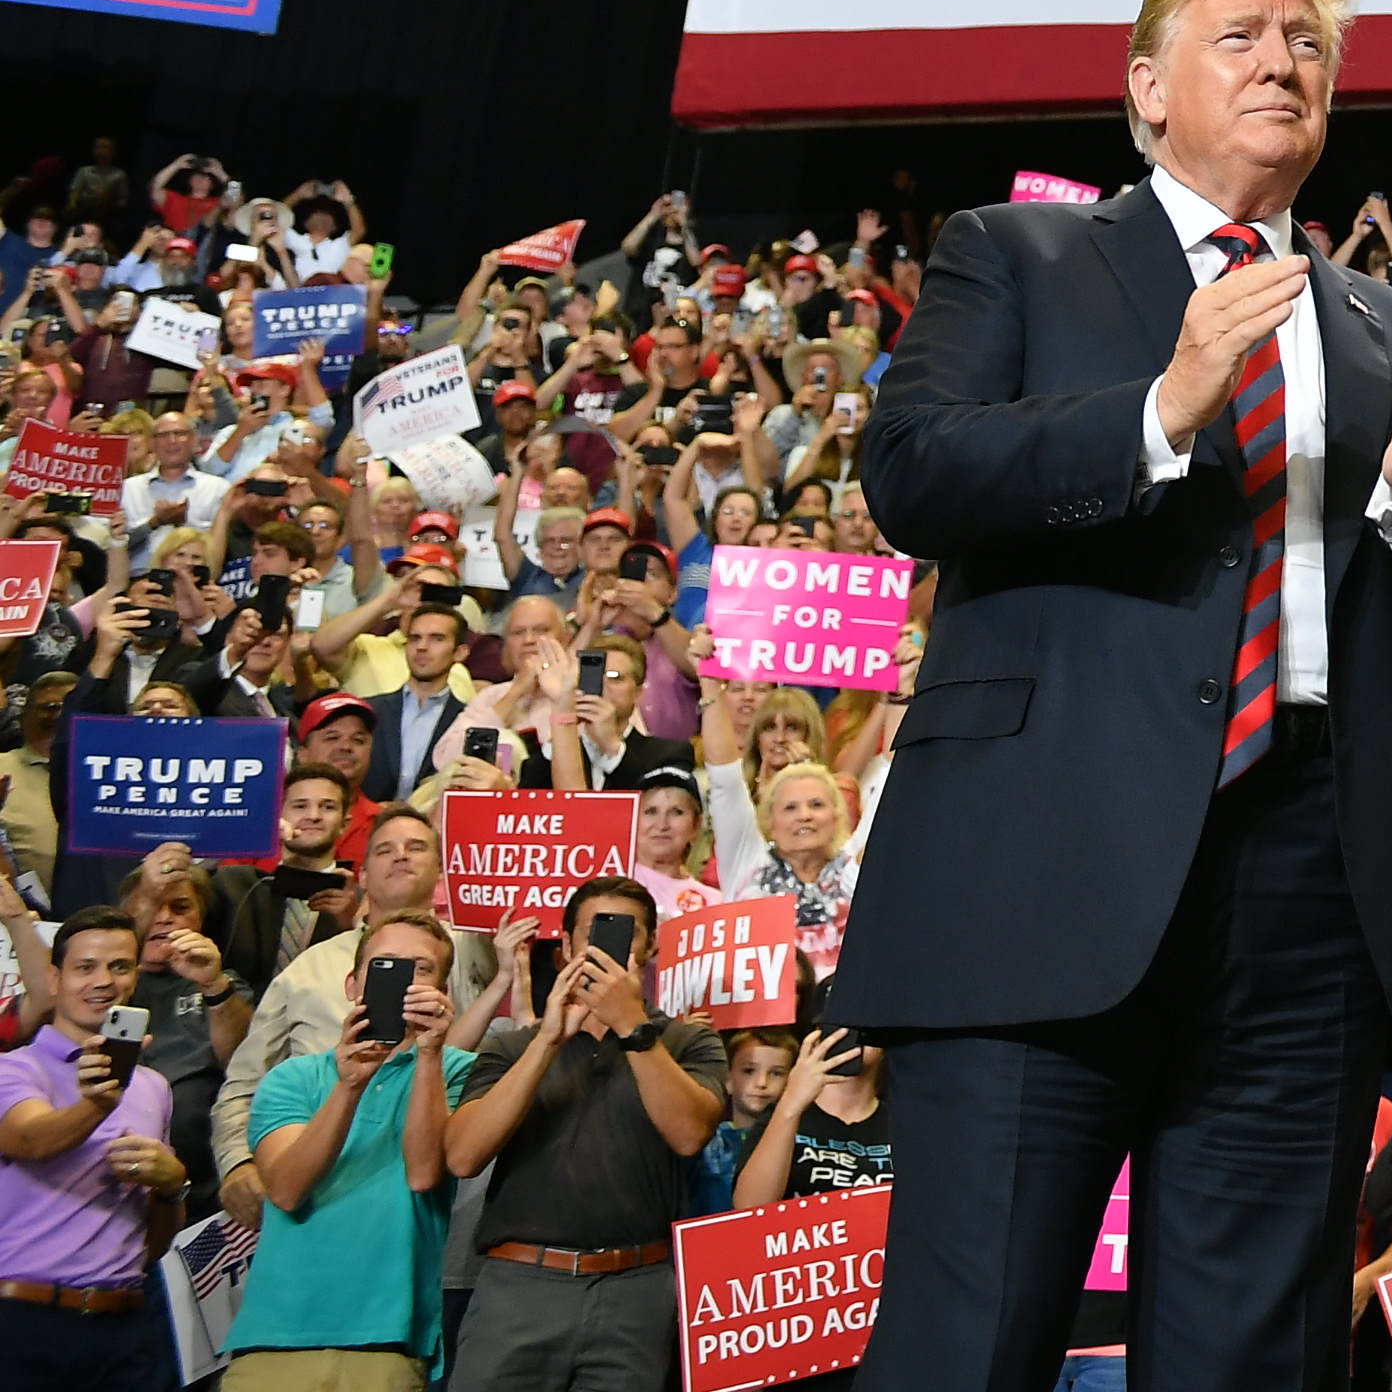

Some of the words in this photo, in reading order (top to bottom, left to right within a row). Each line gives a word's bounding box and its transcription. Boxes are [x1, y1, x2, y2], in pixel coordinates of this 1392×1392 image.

[262, 303, 358, 322] TRUMP
[395, 353, 459, 381] VETERANS
[376, 375, 465, 414] TRUMP
[53, 443, 100, 459] MAKE
[13, 450, 123, 484] AMERICA
[716, 556, 911, 600] WOMEN
[772, 606, 842, 630] FOR
[714, 638, 890, 678] TRUMP
[84, 756, 263, 783] TRUMP
[99, 785, 243, 803] PENCE
[94, 806, 120, 815] MAKE
[122, 807, 167, 817] AMERICA
[169, 809, 205, 817] GREAT
[207, 809, 248, 817] AGAIN!
[497, 815, 564, 835] MAKE
[448, 845, 626, 877] AMERICA
[458, 884, 517, 907] GREAT
[677, 915, 750, 958] JOSH
[659, 943, 788, 1019] HAWLEY
[797, 1147, 858, 1169] ARE
[765, 1220, 848, 1257] MAKE
[689, 1248, 885, 1327] AMERIC
[699, 1315, 813, 1364] PROUD
